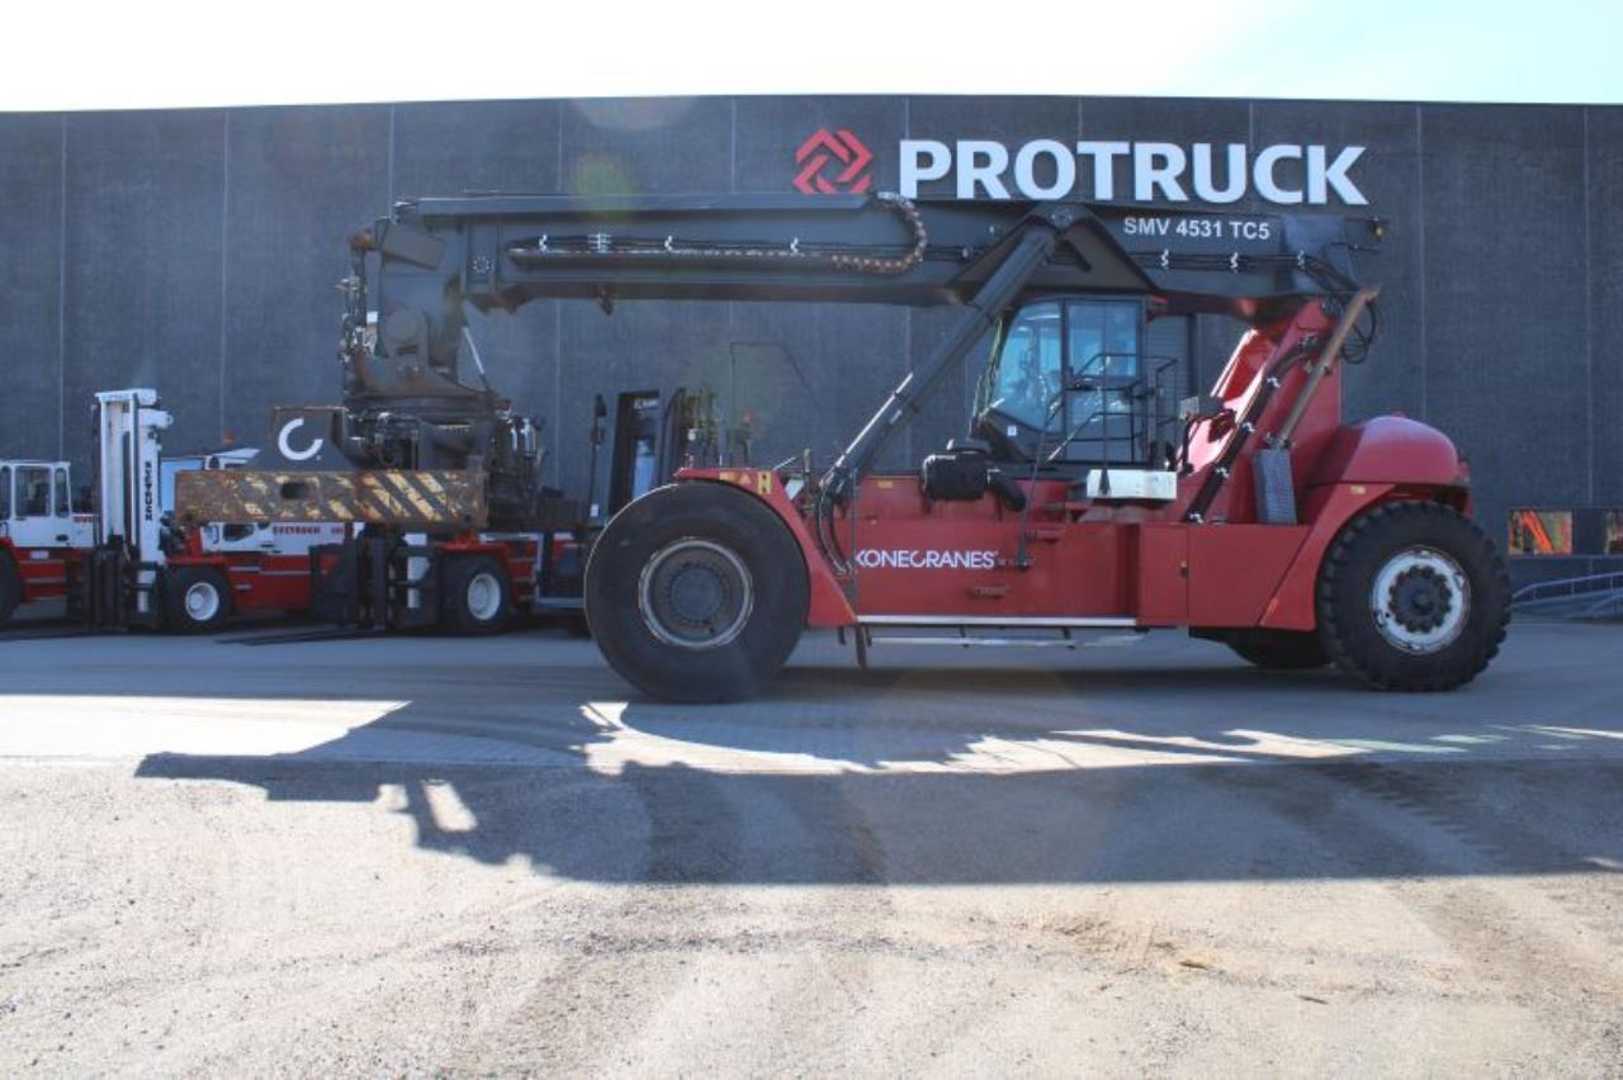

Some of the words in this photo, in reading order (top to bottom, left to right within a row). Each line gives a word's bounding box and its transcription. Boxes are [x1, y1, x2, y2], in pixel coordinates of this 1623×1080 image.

[899, 138, 1369, 206] PROTRUCK
[1124, 216, 1170, 236] SMV
[1176, 219, 1222, 238] 4531
[1229, 221, 1270, 240] TC5
